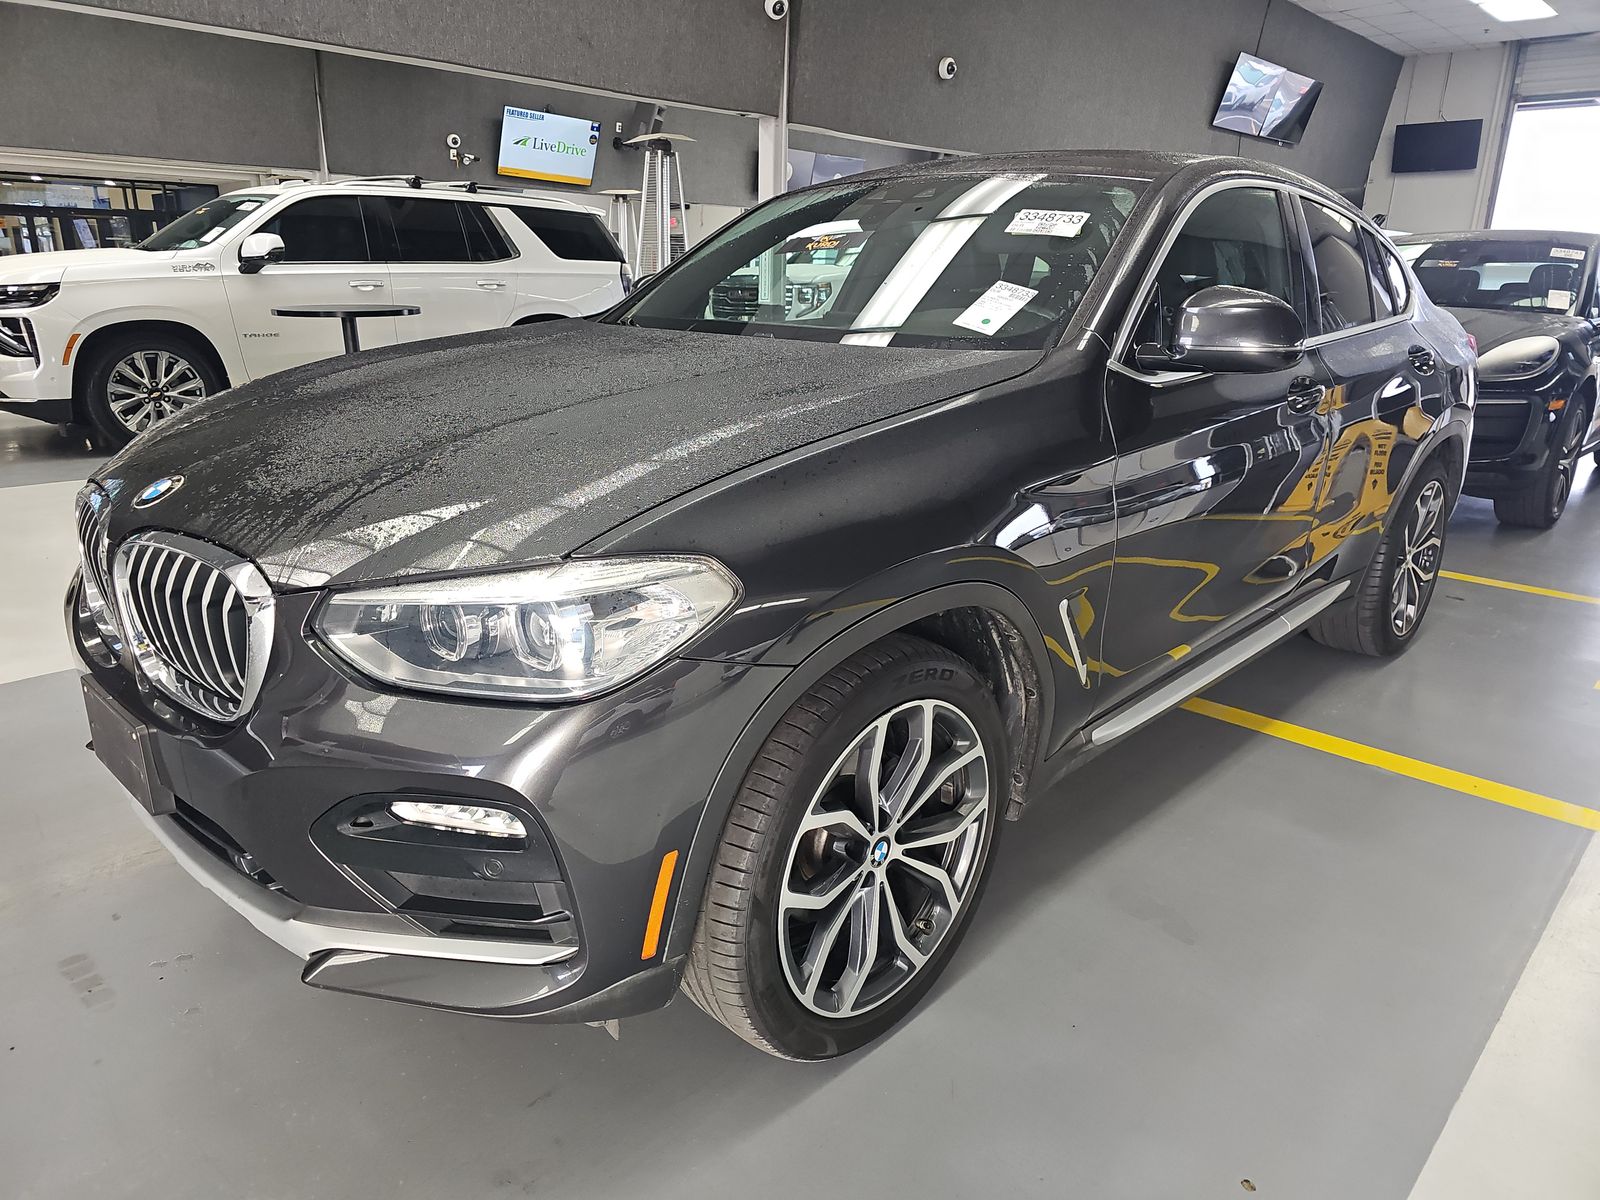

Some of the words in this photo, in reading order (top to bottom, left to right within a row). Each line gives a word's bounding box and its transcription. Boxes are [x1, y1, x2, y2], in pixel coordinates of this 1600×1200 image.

[506, 108, 529, 118] FEATURED
[529, 112, 545, 121] SELLER
[532, 137, 587, 157] LiveDrive
[1019, 211, 1084, 225] 3348733
[995, 282, 1036, 299] 3348733
